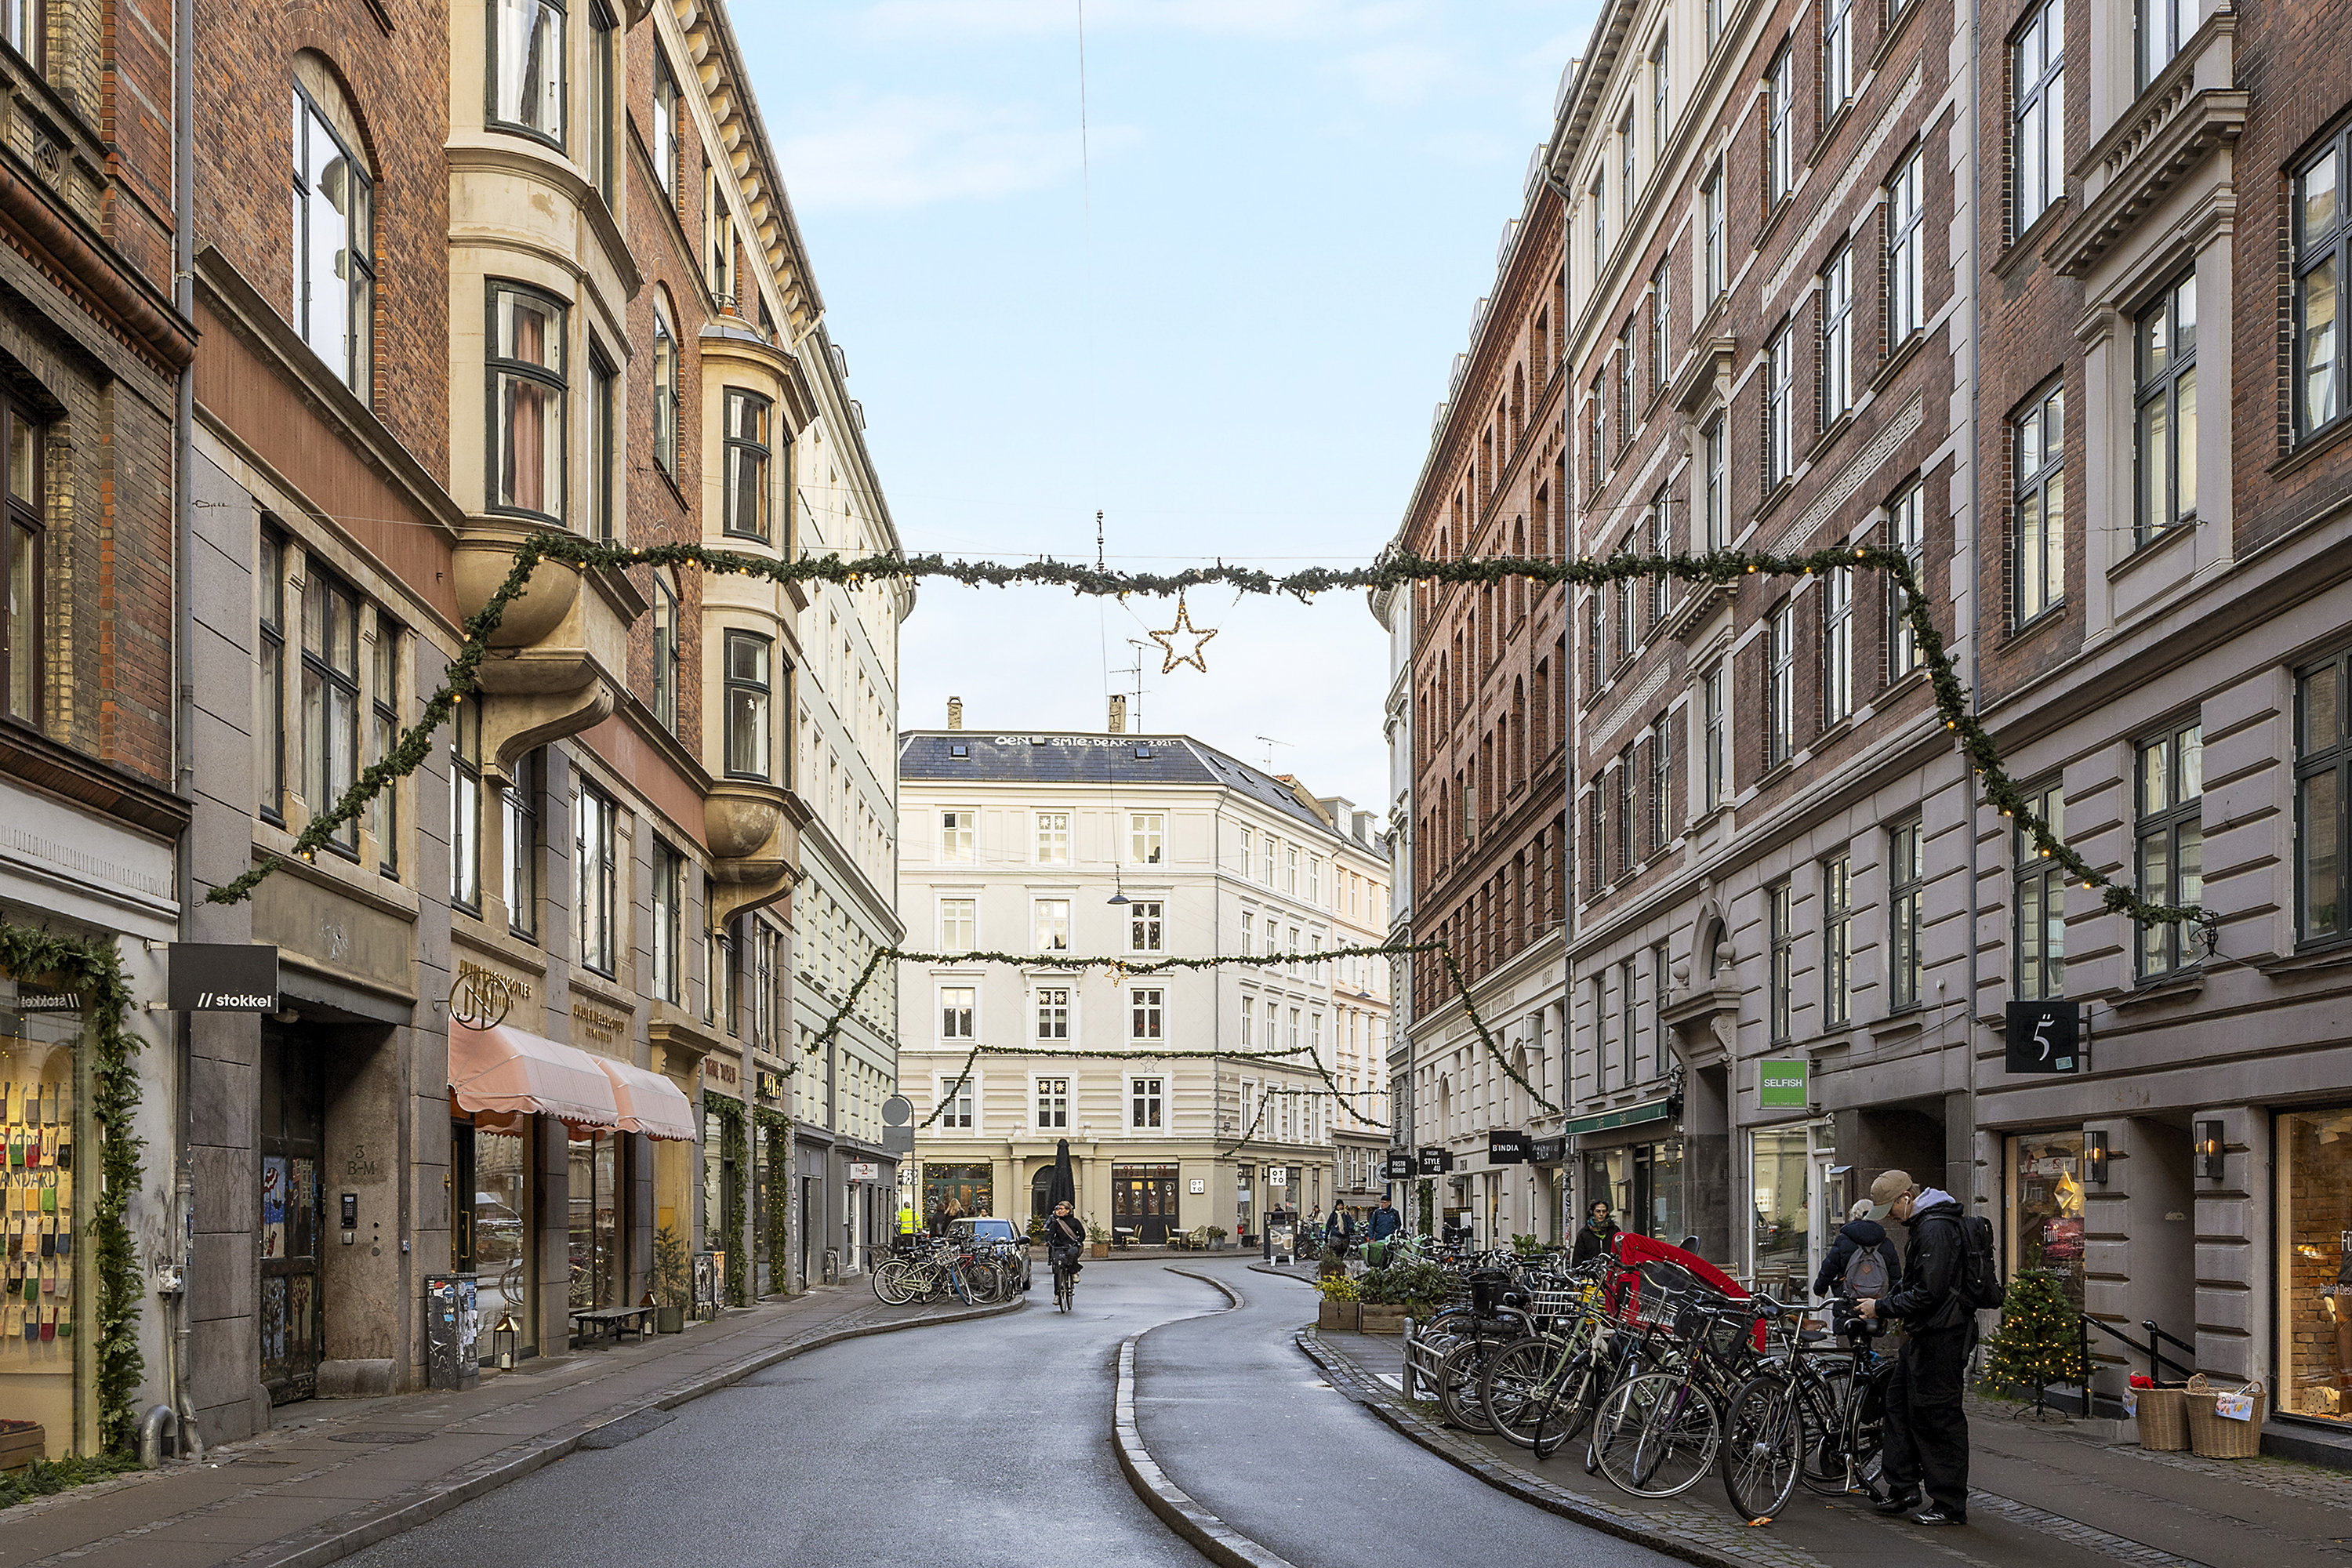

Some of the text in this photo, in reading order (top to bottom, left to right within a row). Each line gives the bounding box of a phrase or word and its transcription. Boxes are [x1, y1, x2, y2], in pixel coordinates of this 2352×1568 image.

[216, 993, 272, 1008] stokkel
[1764, 1078, 1802, 1087] SELFISH
[355, 1145, 365, 1159] 3
[347, 1160, 375, 1175] B-M
[2320, 1283, 2339, 1295] Danish
